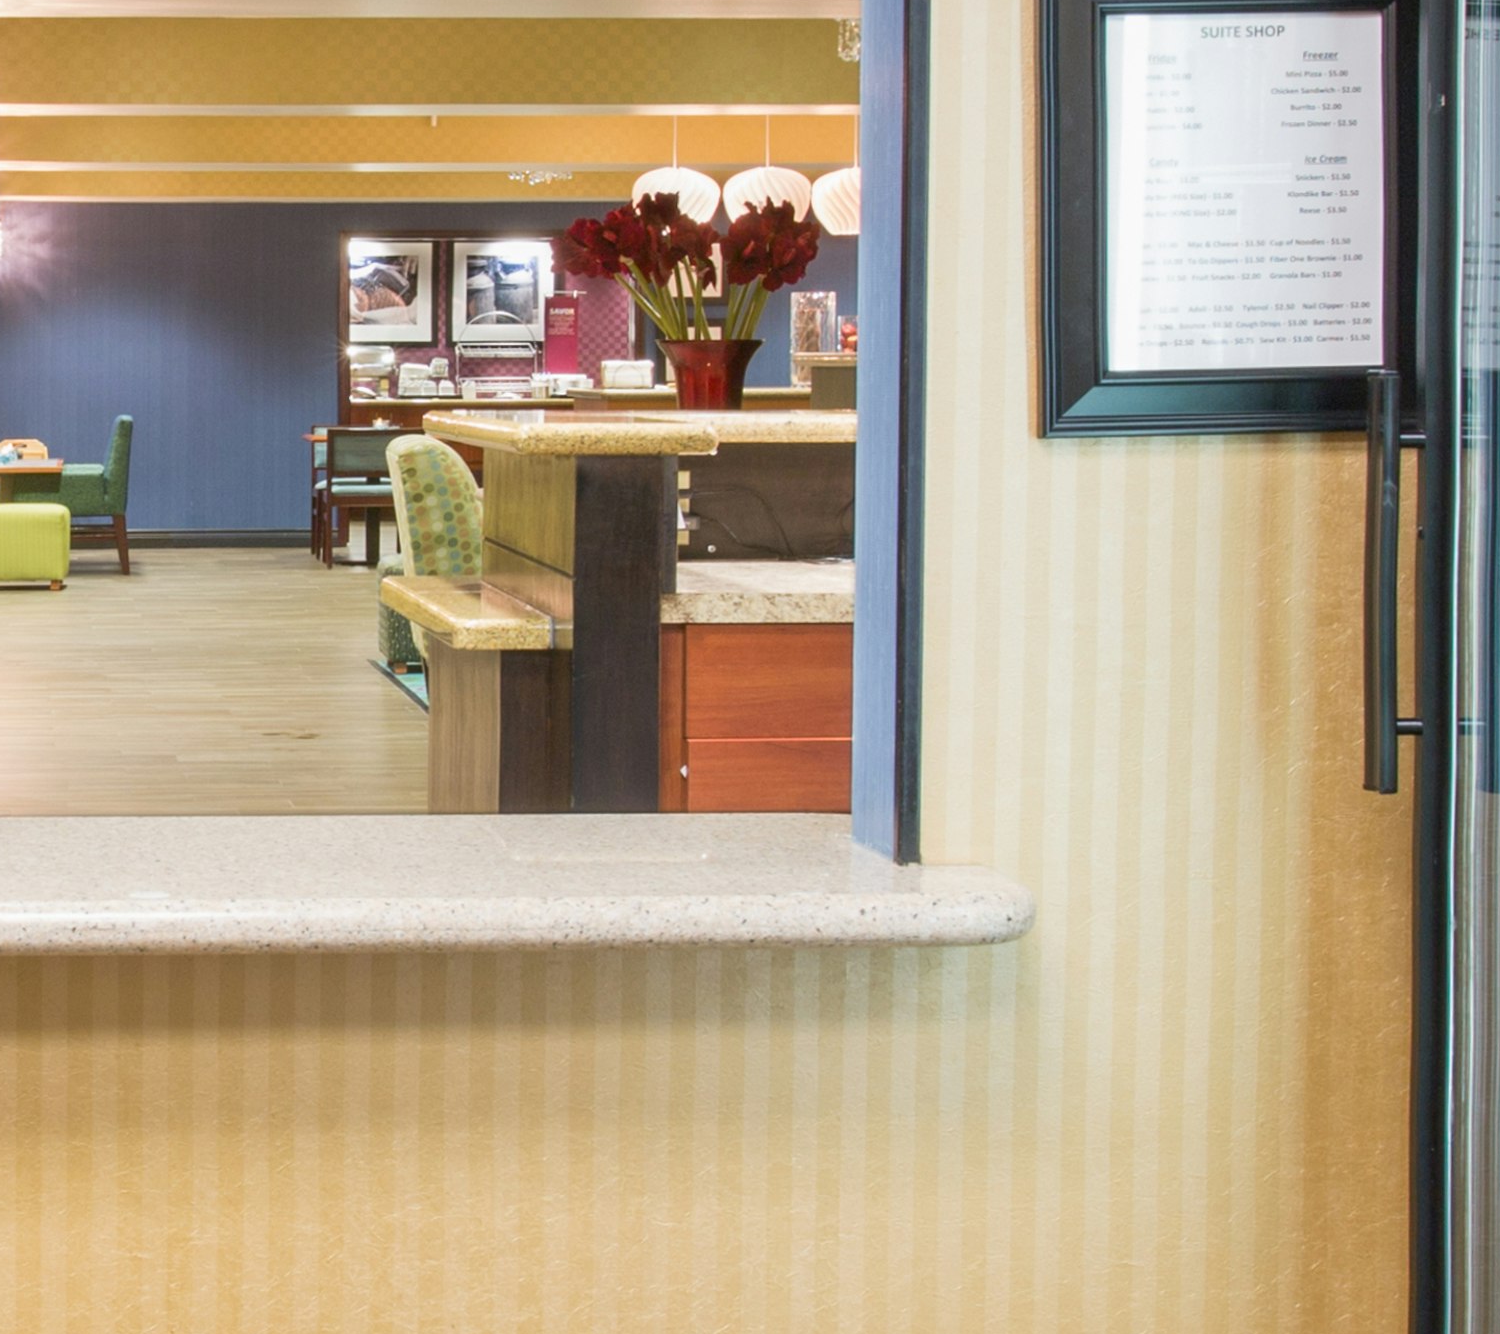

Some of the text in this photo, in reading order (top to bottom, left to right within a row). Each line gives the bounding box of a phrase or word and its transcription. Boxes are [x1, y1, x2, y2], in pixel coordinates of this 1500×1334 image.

[1200, 24, 1286, 39] SUITE SHOP
[1302, 50, 1339, 61] Freezer
[1270, 86, 1336, 95] Chicken Sandwich
[1290, 103, 1316, 111] Burrito
[1307, 119, 1331, 127] Dinner
[1304, 155, 1348, 164] Ice Cream
